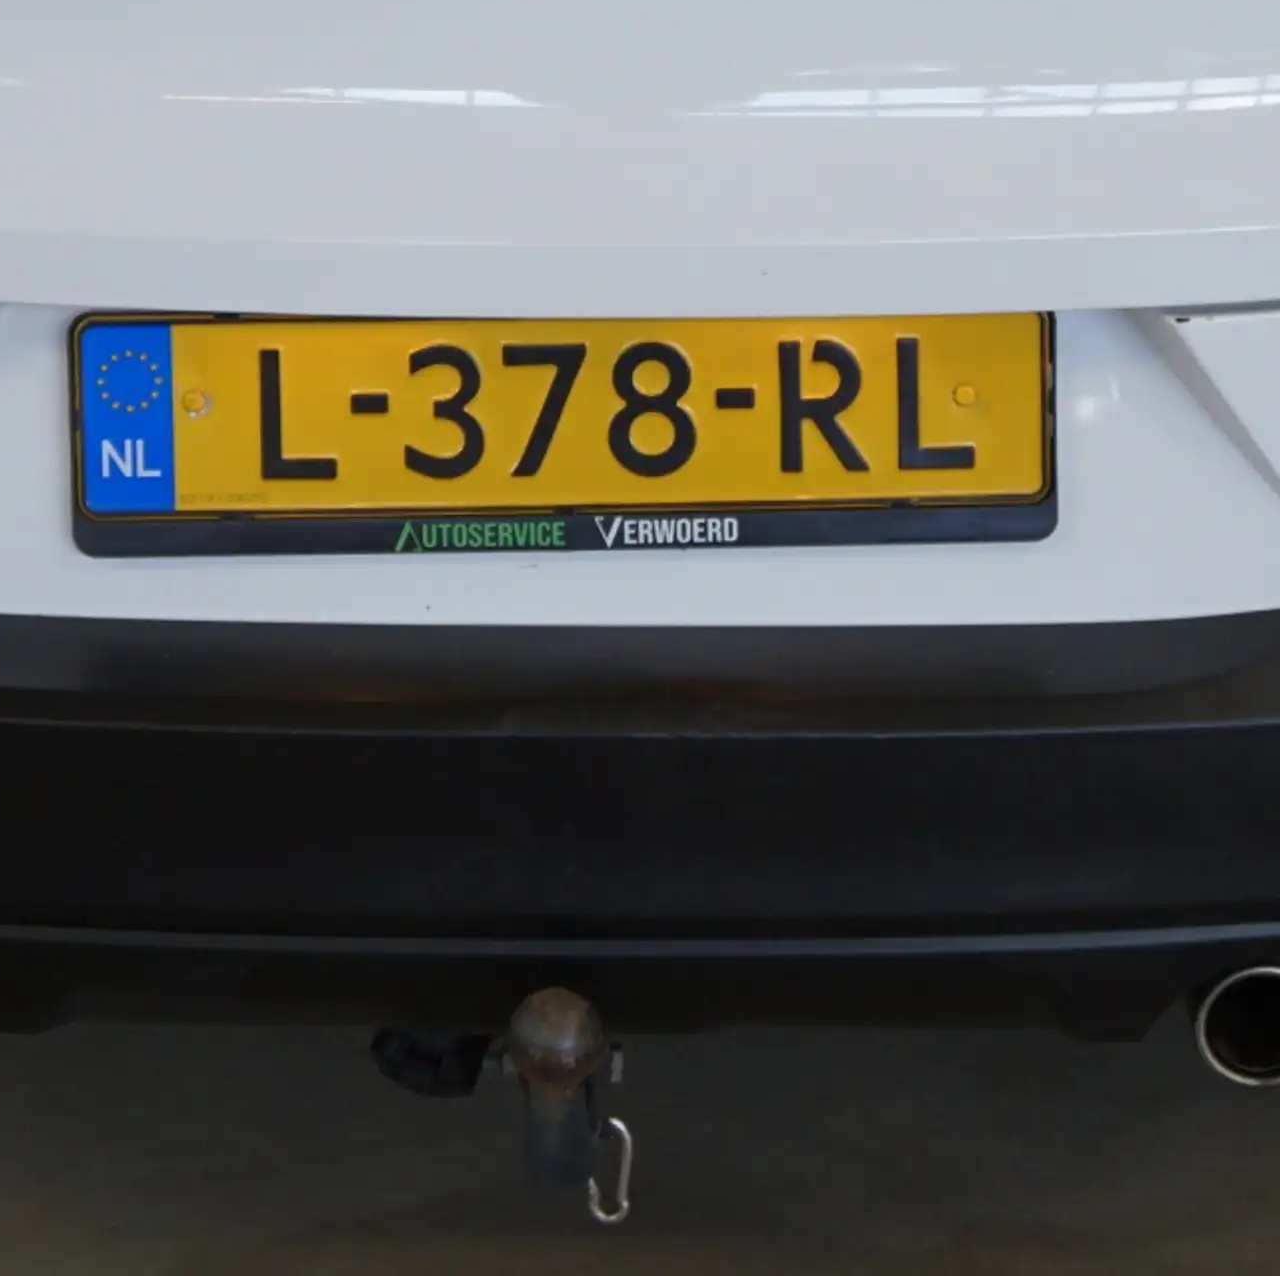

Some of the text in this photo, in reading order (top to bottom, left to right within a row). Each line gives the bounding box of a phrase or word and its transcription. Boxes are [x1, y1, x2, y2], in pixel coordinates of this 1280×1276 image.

[258, 336, 976, 482] L-378-RL
[99, 438, 161, 479] NL
[394, 515, 739, 553] AUTOSERVICE VERWOERD
